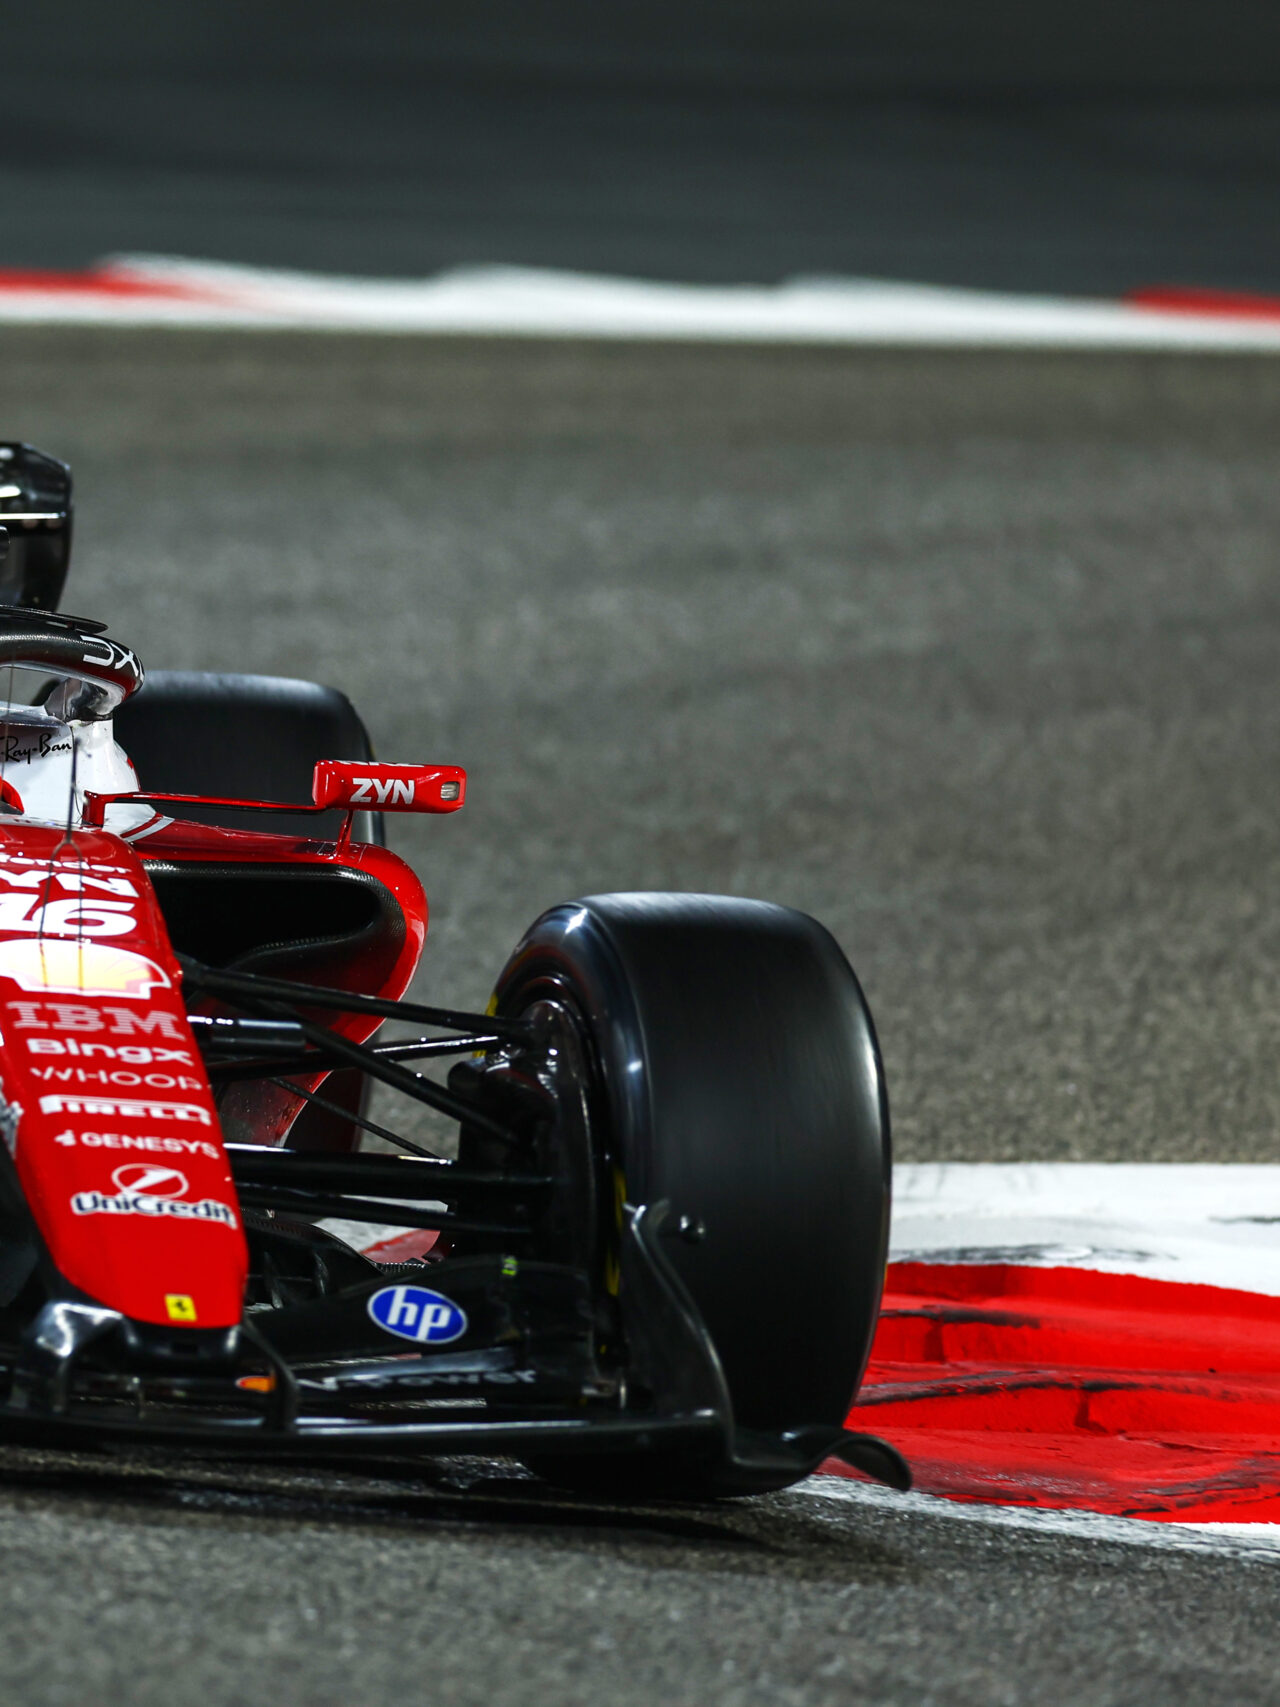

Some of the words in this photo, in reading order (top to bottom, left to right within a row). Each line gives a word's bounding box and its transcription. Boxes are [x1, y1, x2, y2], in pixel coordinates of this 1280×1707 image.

[80, 634, 145, 684] DX
[349, 777, 415, 805] ZYN
[6, 1000, 187, 1042] IBM
[29, 1065, 204, 1091] WHOOP
[38, 1094, 212, 1127] PIRELLI
[80, 1131, 220, 1160] GENESYS
[73, 1191, 235, 1228] UniCredit
[386, 1285, 451, 1342] hp
